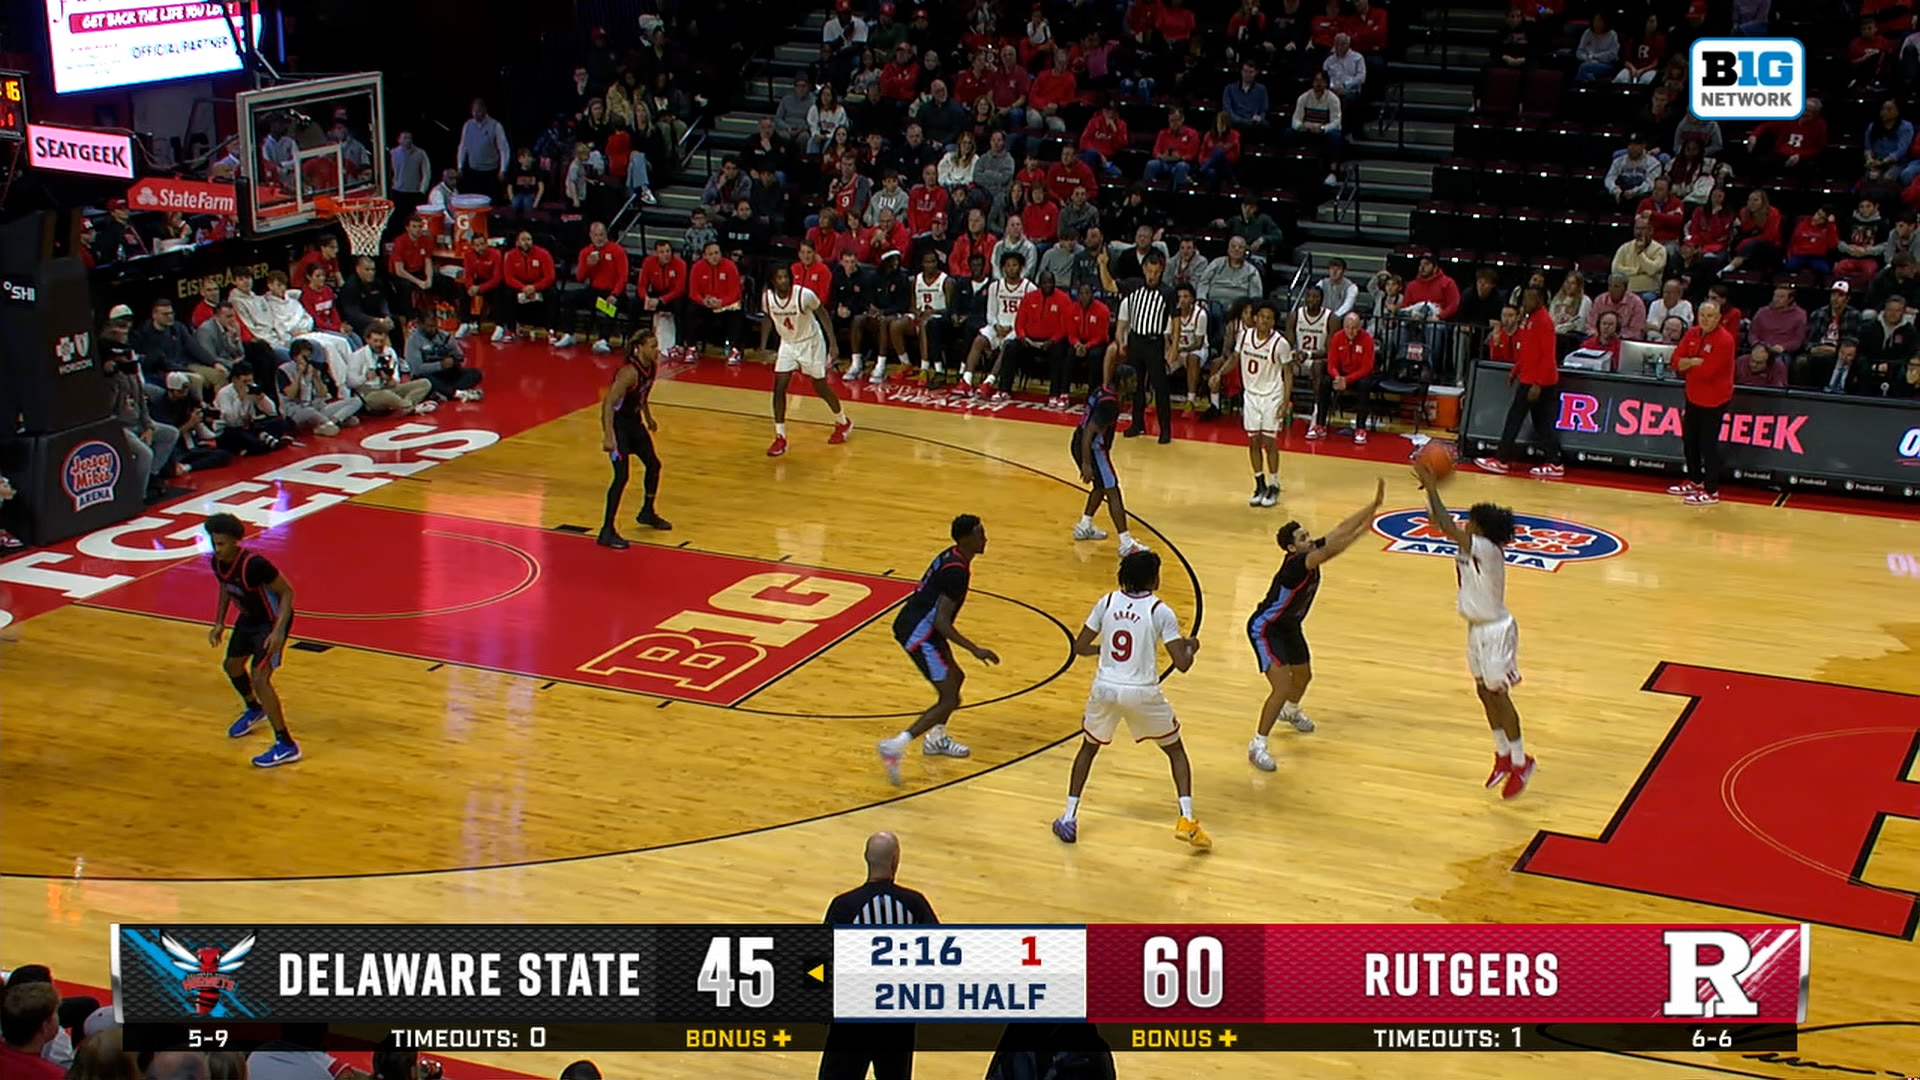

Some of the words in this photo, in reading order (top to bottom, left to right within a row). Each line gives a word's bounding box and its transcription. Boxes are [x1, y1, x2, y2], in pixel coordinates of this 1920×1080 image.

[82, 14, 104, 29] GET
[106, 12, 137, 26] BACK
[138, 10, 159, 23] THE
[159, 6, 185, 21] LIFE
[130, 43, 181, 59] OFFICIAL
[182, 35, 229, 53] PARTNER
[35, 136, 128, 169] SEATGEEK
[783, 317, 795, 331] 4
[1302, 335, 1318, 351] 21
[1247, 359, 1259, 375] 0
[1555, 392, 1599, 433] R
[1614, 398, 1809, 455] SEAEEK
[70, 452, 114, 475] Jersey
[79, 487, 112, 508] ARENA
[1401, 543, 1546, 569] ARNA
[1113, 610, 1141, 624] GRANT
[1111, 629, 1133, 662] 9
